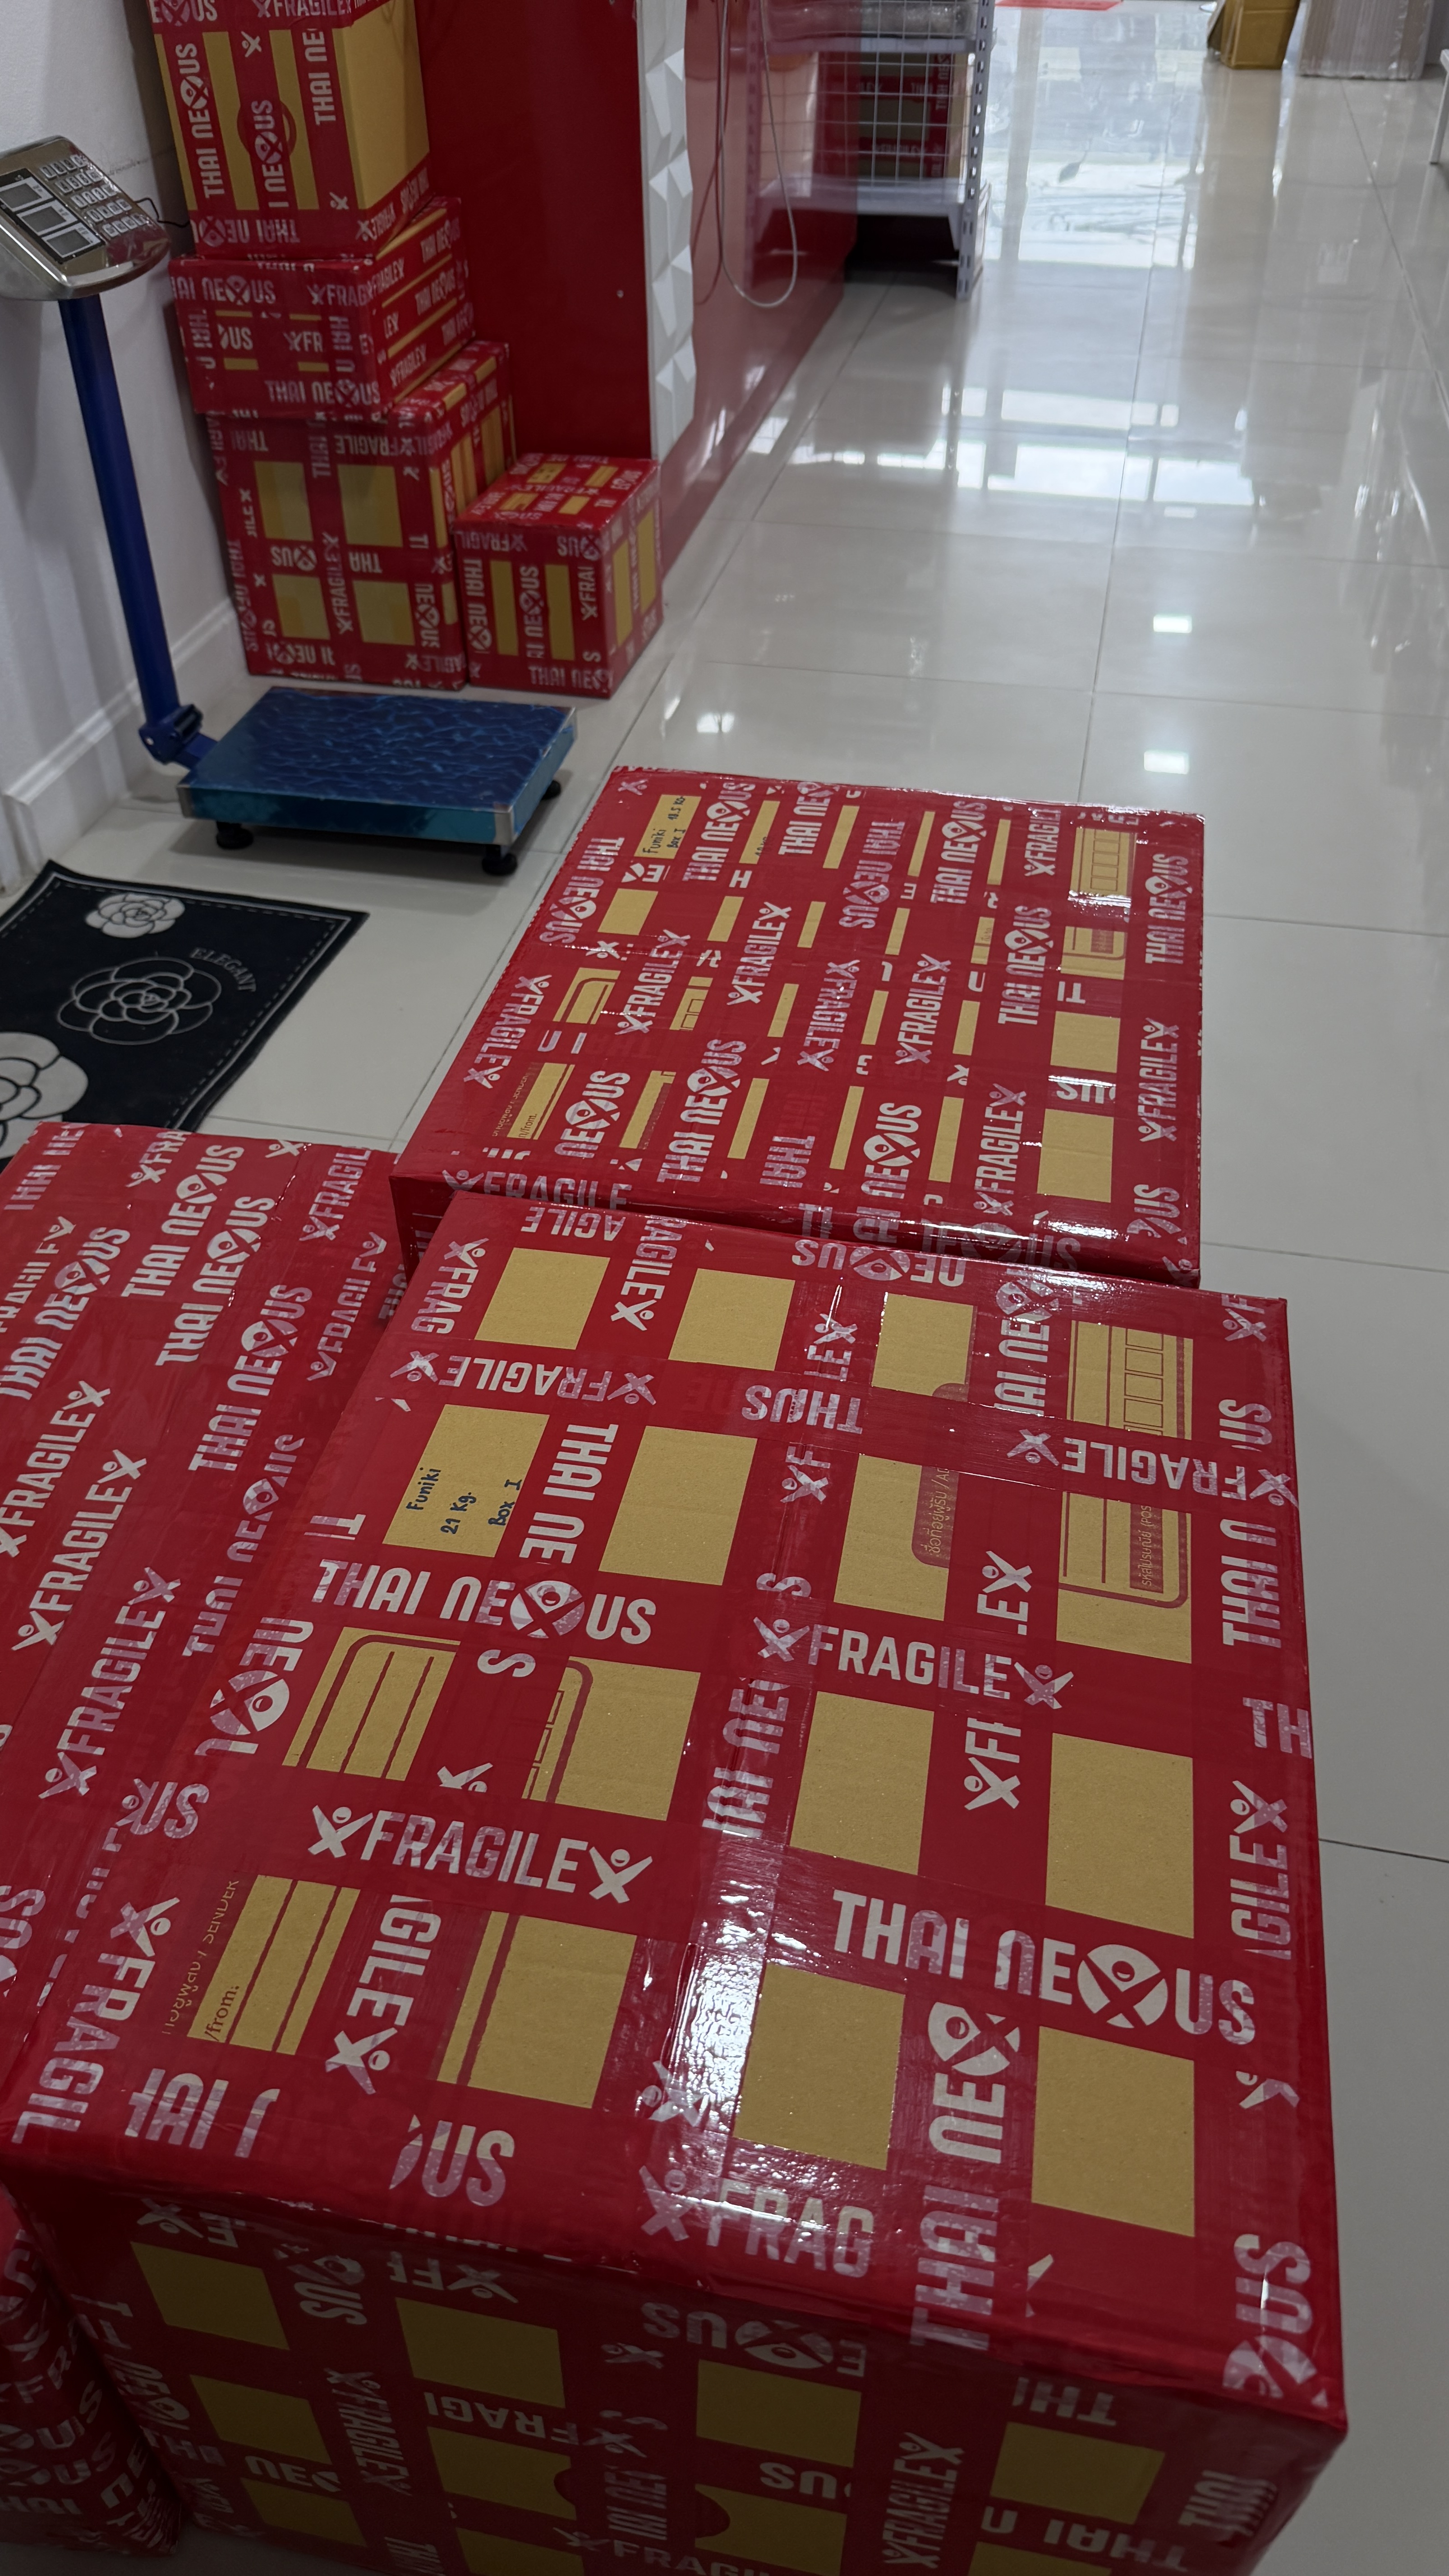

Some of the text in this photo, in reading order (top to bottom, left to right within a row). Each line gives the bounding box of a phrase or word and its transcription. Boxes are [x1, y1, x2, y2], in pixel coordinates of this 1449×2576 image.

[682, 781, 756, 881] THAI NEXUS
[778, 820, 823, 856] THAI
[838, 820, 906, 929] THAI NEXUS
[941, 800, 988, 865] NEXUS
[189, 947, 257, 993] ELEGANT
[998, 905, 1054, 1026] THAI NEXUS
[554, 1070, 631, 1159] NEXUS
[657, 1039, 747, 1183] THAI NEXUS
[860, 1102, 922, 1200] NEXUS
[759, 1135, 816, 1189] THAI
[120, 1145, 244, 1297] THAI NEXUS
[34, 1227, 131, 1331] NEXUS
[155, 1196, 276, 1366] THAI NEXUS
[188, 1284, 313, 1472] THAI NEXUS
[406, 1467, 442, 1511] Funiki
[543, 1423, 619, 1501] THAI
[440, 1517, 461, 1535] 21
[488, 1501, 515, 1526] Box
[311, 1559, 657, 1645] THAI NEXUS
[1220, 1555, 1282, 1649] THAI
[832, 1889, 1256, 2045] THAI NEXUS
[909, 2184, 999, 2351] THAI
